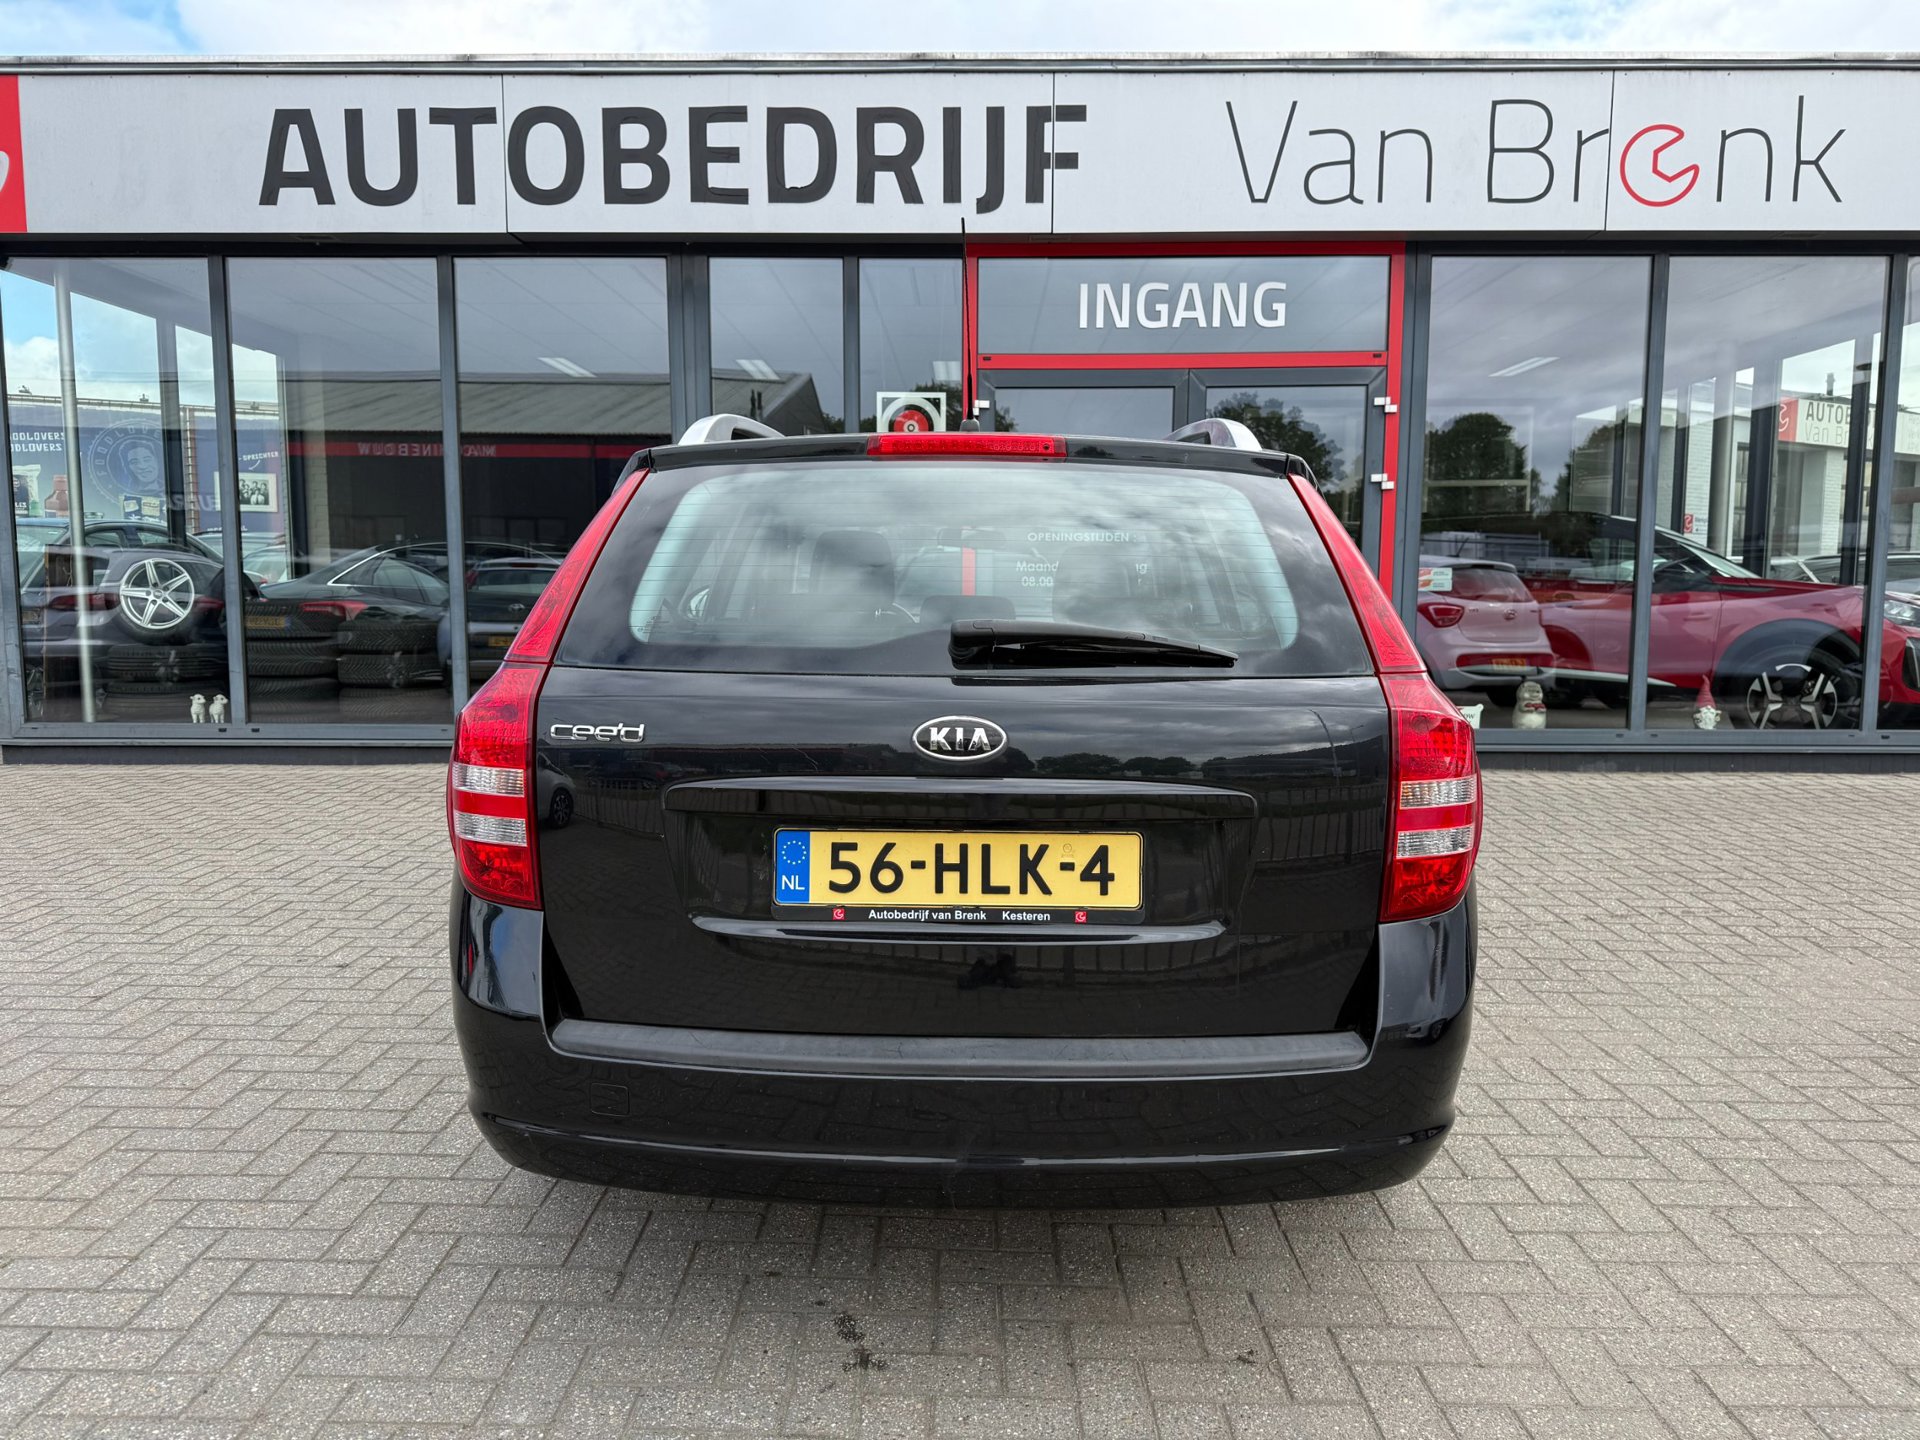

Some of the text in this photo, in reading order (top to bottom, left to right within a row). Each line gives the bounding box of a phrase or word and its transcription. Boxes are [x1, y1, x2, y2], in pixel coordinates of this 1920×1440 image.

[259, 95, 1847, 214] AUTOBEDRIJF Van Brenk
[1079, 281, 1287, 329] INGANG
[1027, 532, 1130, 542] OPENINGSTIJDEN
[929, 727, 991, 751] KIA
[781, 842, 1115, 896] NL 56-HLK-4
[868, 909, 1051, 921] Autobedrijf van Brenk Kesteren
